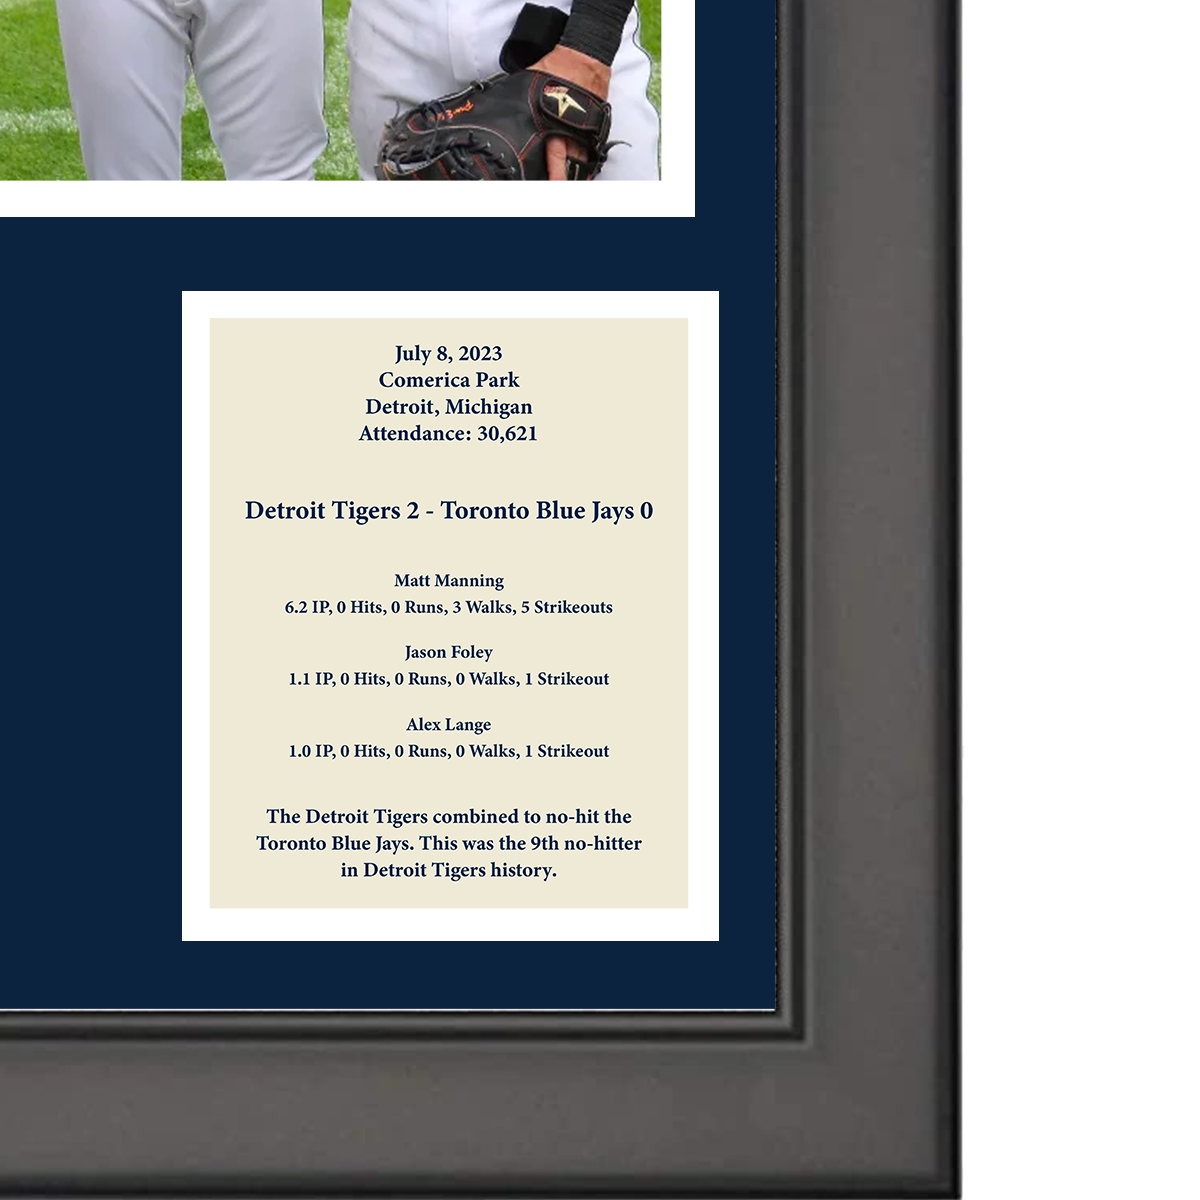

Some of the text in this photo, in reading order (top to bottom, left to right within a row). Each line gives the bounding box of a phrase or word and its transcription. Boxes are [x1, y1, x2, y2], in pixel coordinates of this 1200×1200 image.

[394, 344, 503, 366] July 8, 2023
[378, 370, 521, 388] Comerica Park
[365, 397, 533, 420] Detroit, Michigan
[358, 424, 538, 444] Attendance: 30,621
[245, 500, 326, 520] Detroit
[331, 500, 401, 526] Tigers
[406, 501, 420, 520] 2
[440, 500, 530, 520] Toronto
[536, 499, 586, 520] Blue
[591, 500, 635, 526] Jays
[640, 501, 654, 520] 0
[394, 573, 505, 592] Matt Manning
[284, 599, 613, 616] 6.2 IP, 0 Hits, 0 Runs, 3 Walks, 5 Strikeouts
[404, 644, 494, 663] Jason Foley
[289, 671, 610, 688] 1.1 IP, 0 Hits, 0 Runs, 0 Walks, 1 Strikeout
[405, 716, 492, 736] Alex Lange
[289, 743, 610, 760] 1.0 IP, 0 Hits, 0 Runs, 0 Walks, 1 Strikeout
[265, 808, 632, 829] The Detroit Tigers combined to no-hit the
[255, 834, 643, 856] Toronto Blue Jays. This was the 9th no-hitter
[341, 861, 557, 882] in Detroit Tigers history.
